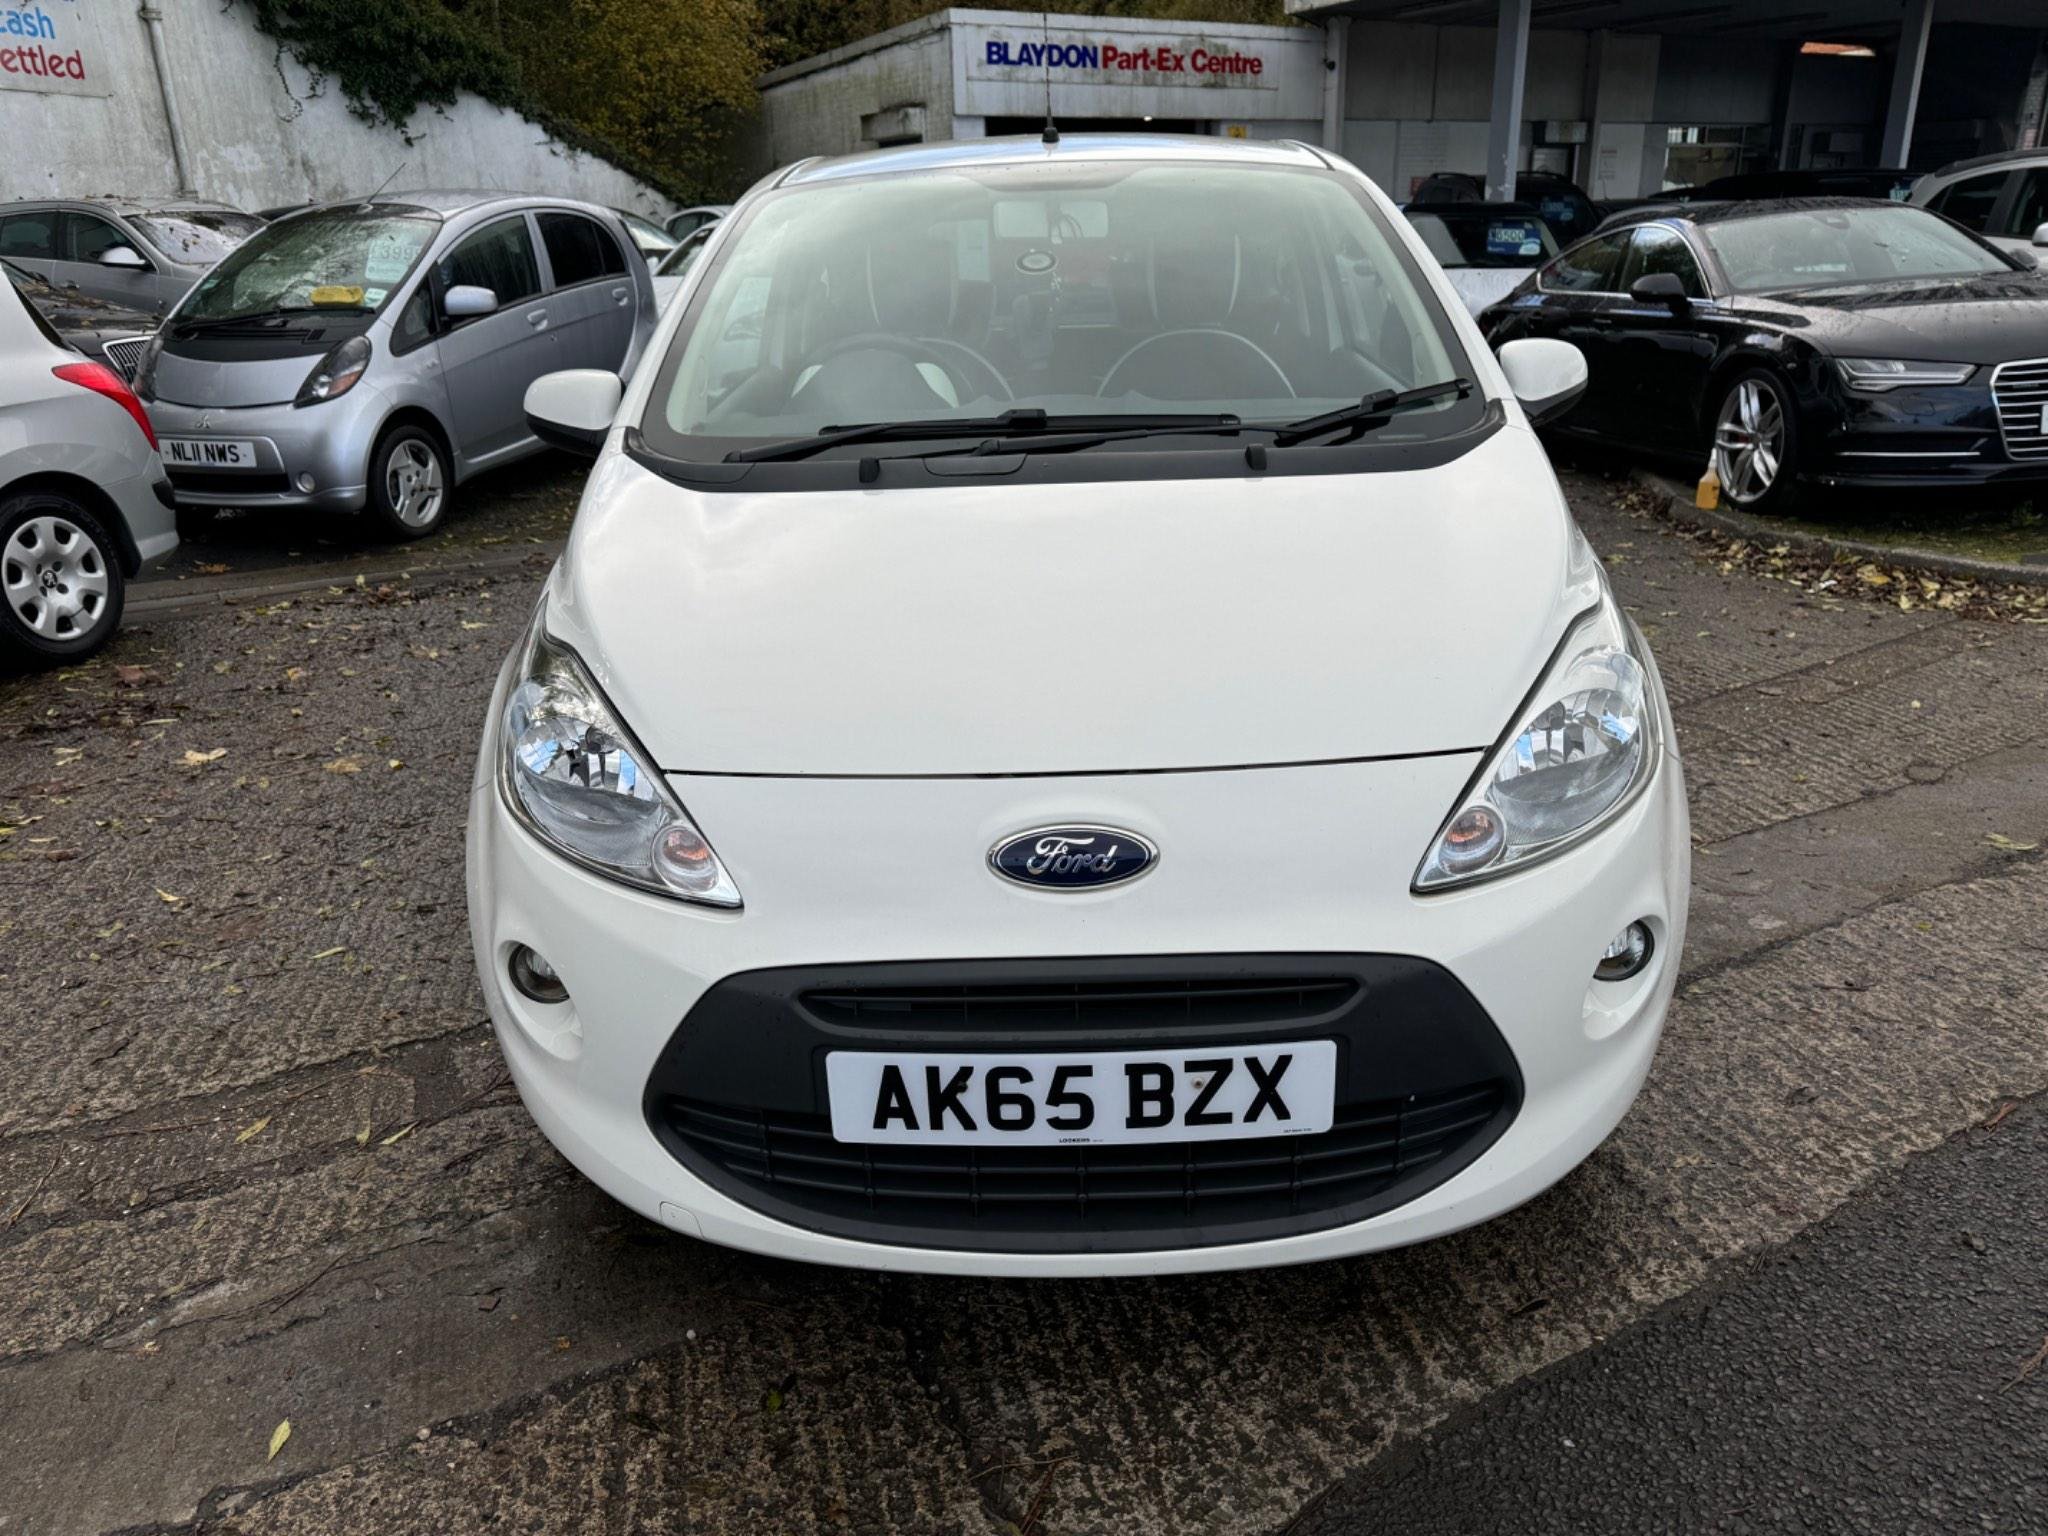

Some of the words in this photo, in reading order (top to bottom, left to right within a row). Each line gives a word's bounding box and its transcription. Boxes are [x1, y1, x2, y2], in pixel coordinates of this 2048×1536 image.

[986, 41, 1098, 69] BLAYDON
[1102, 46, 1185, 73] Part-Ex
[1191, 50, 1263, 75] Centre
[171, 442, 201, 462] NL11
[204, 442, 240, 463] NWS
[1026, 836, 1118, 875] Ford
[872, 1065, 1095, 1131] AK65
[1125, 1054, 1294, 1129] BZX
